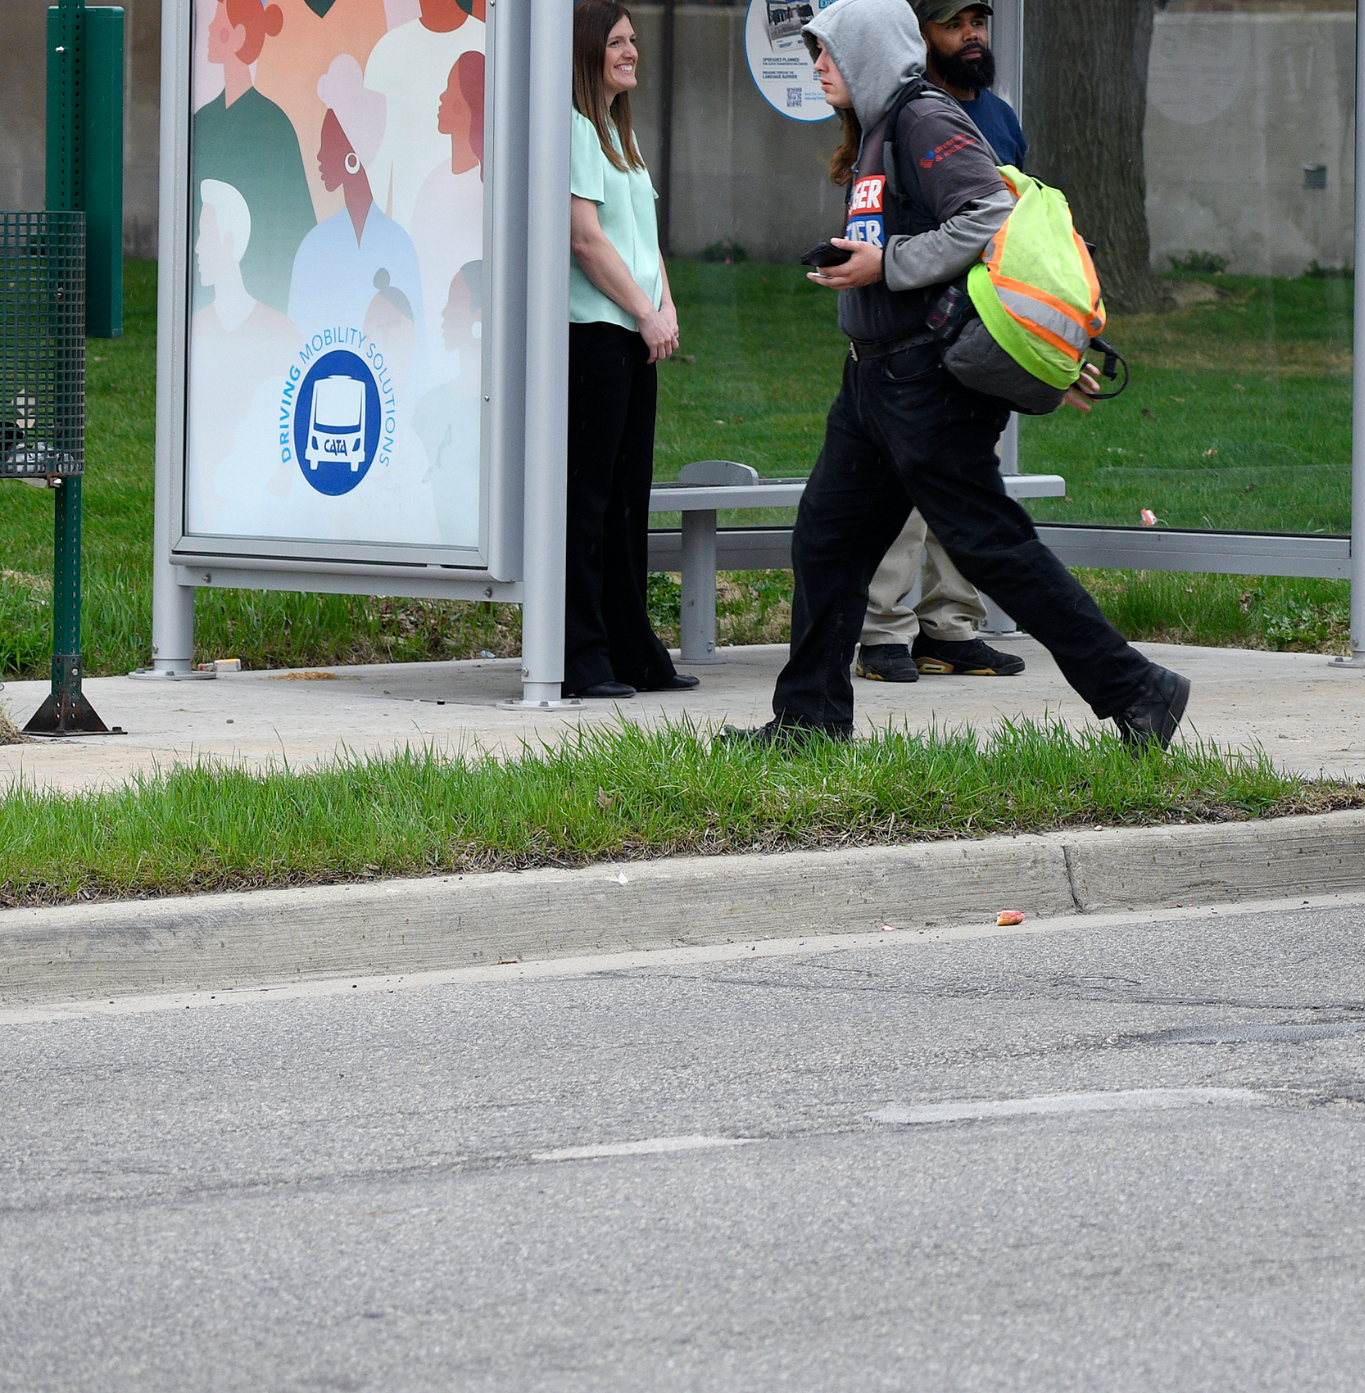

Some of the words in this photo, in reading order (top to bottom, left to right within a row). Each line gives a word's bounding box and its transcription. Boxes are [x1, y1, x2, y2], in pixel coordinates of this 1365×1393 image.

[279, 365, 301, 463] DRIVING
[299, 326, 366, 364] MOBILITY
[366, 343, 396, 467] SOLUTIONS
[324, 439, 348, 456] CATA
